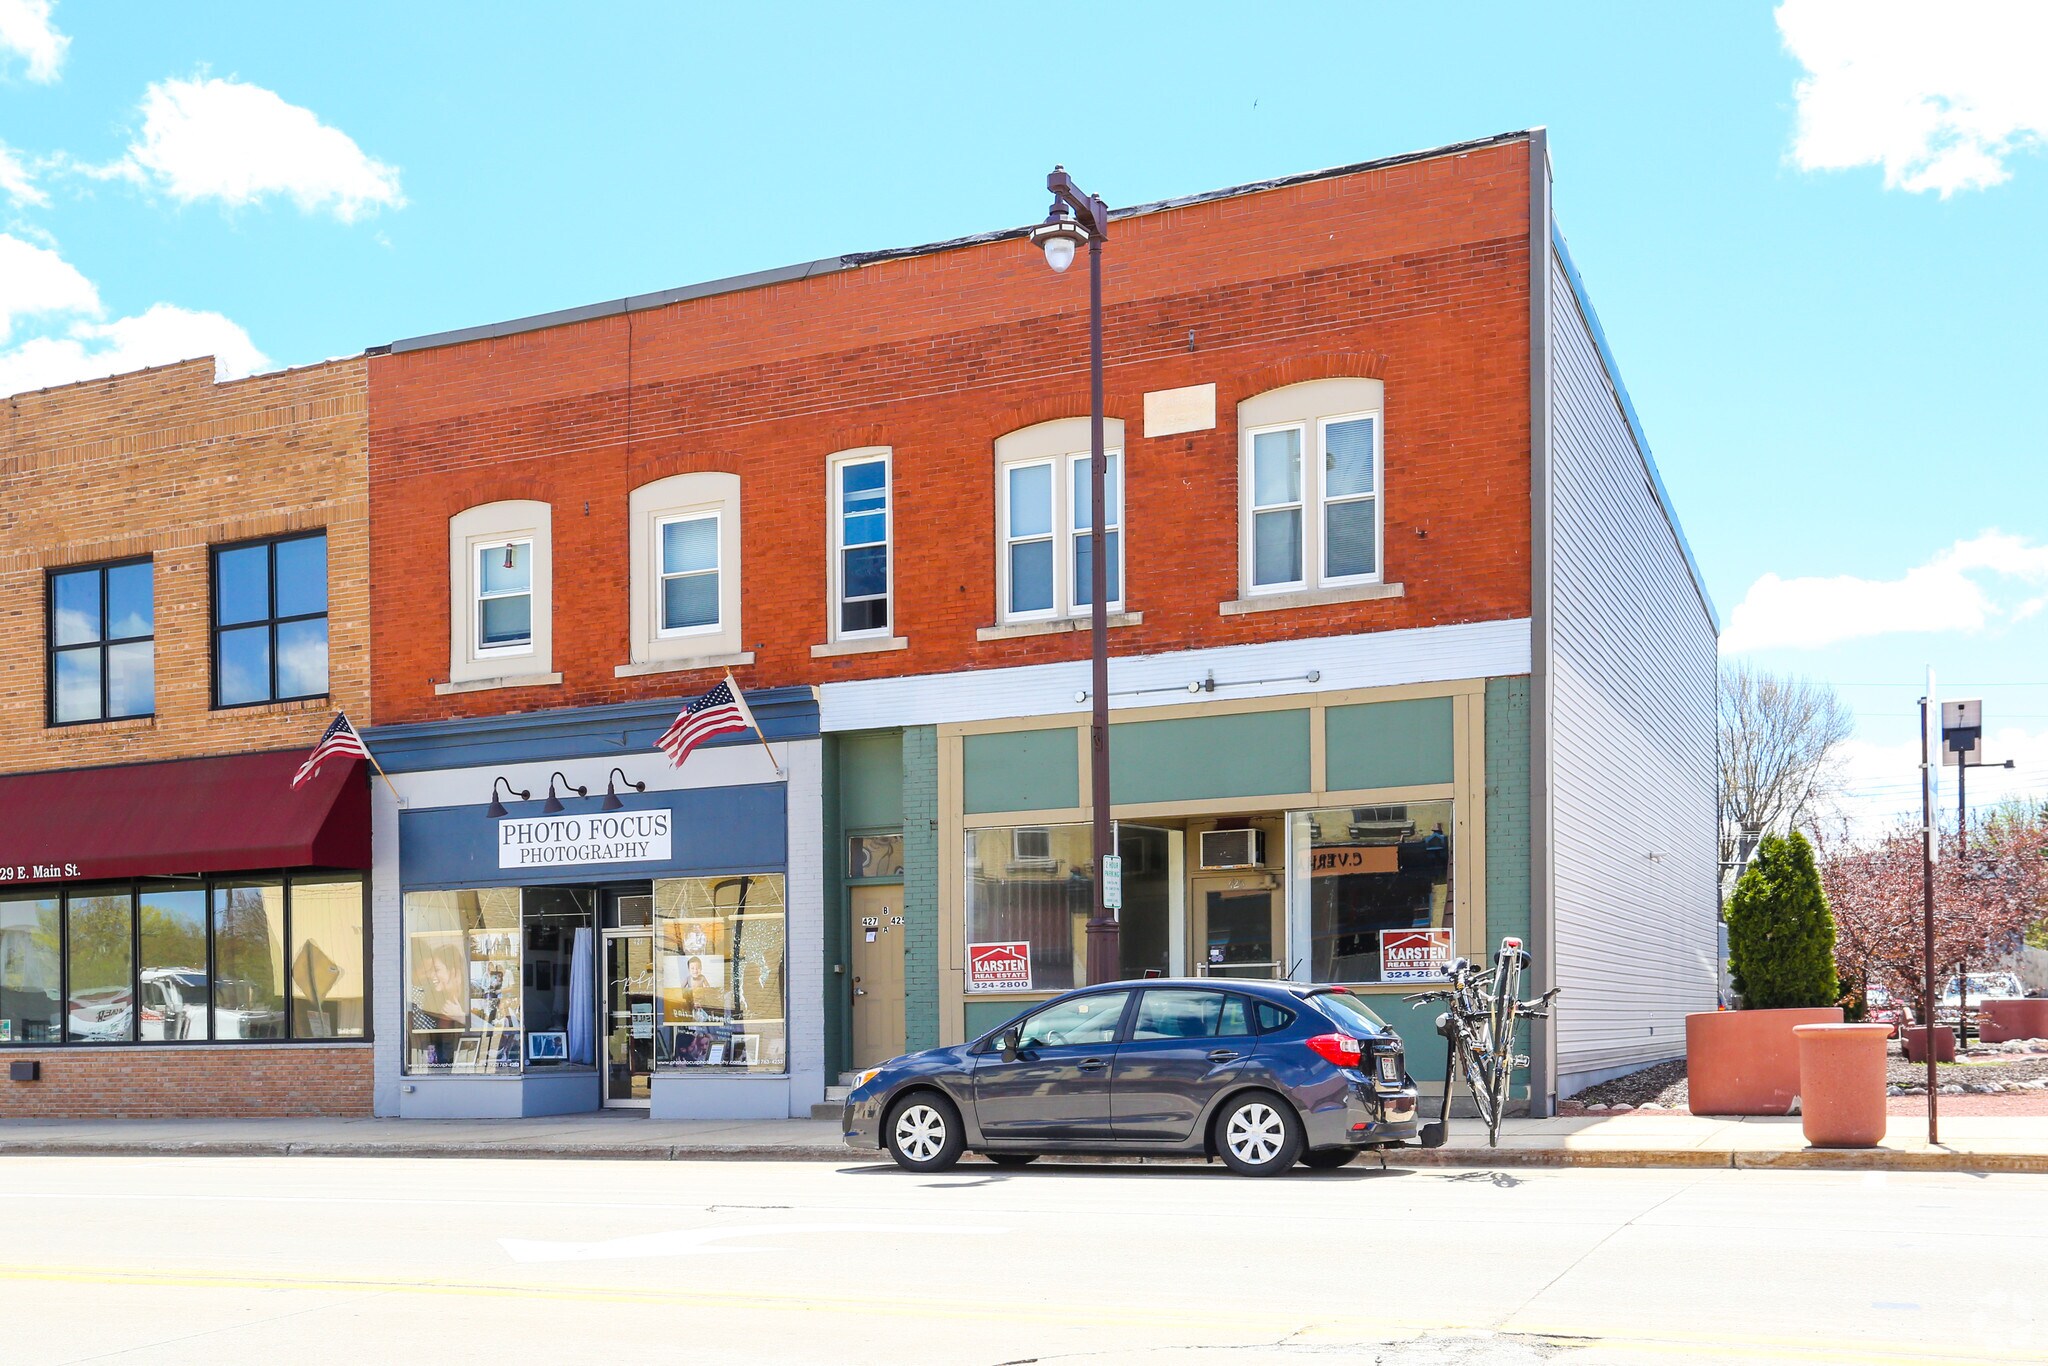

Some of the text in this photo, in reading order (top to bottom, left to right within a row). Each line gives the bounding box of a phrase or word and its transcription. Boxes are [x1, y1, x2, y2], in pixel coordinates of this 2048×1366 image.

[503, 814, 668, 845] PHOTO FOCUS
[520, 841, 650, 864] PHOTOGRAPHY
[0, 863, 81, 880] 29 E. Main St.
[883, 906, 888, 914] B
[862, 917, 877, 925] 427
[1388, 947, 1446, 960] KARSTEN
[975, 960, 1025, 971] KARSTEN
[1387, 970, 1447, 979] 324-280
[974, 981, 1028, 989] 324-2800
